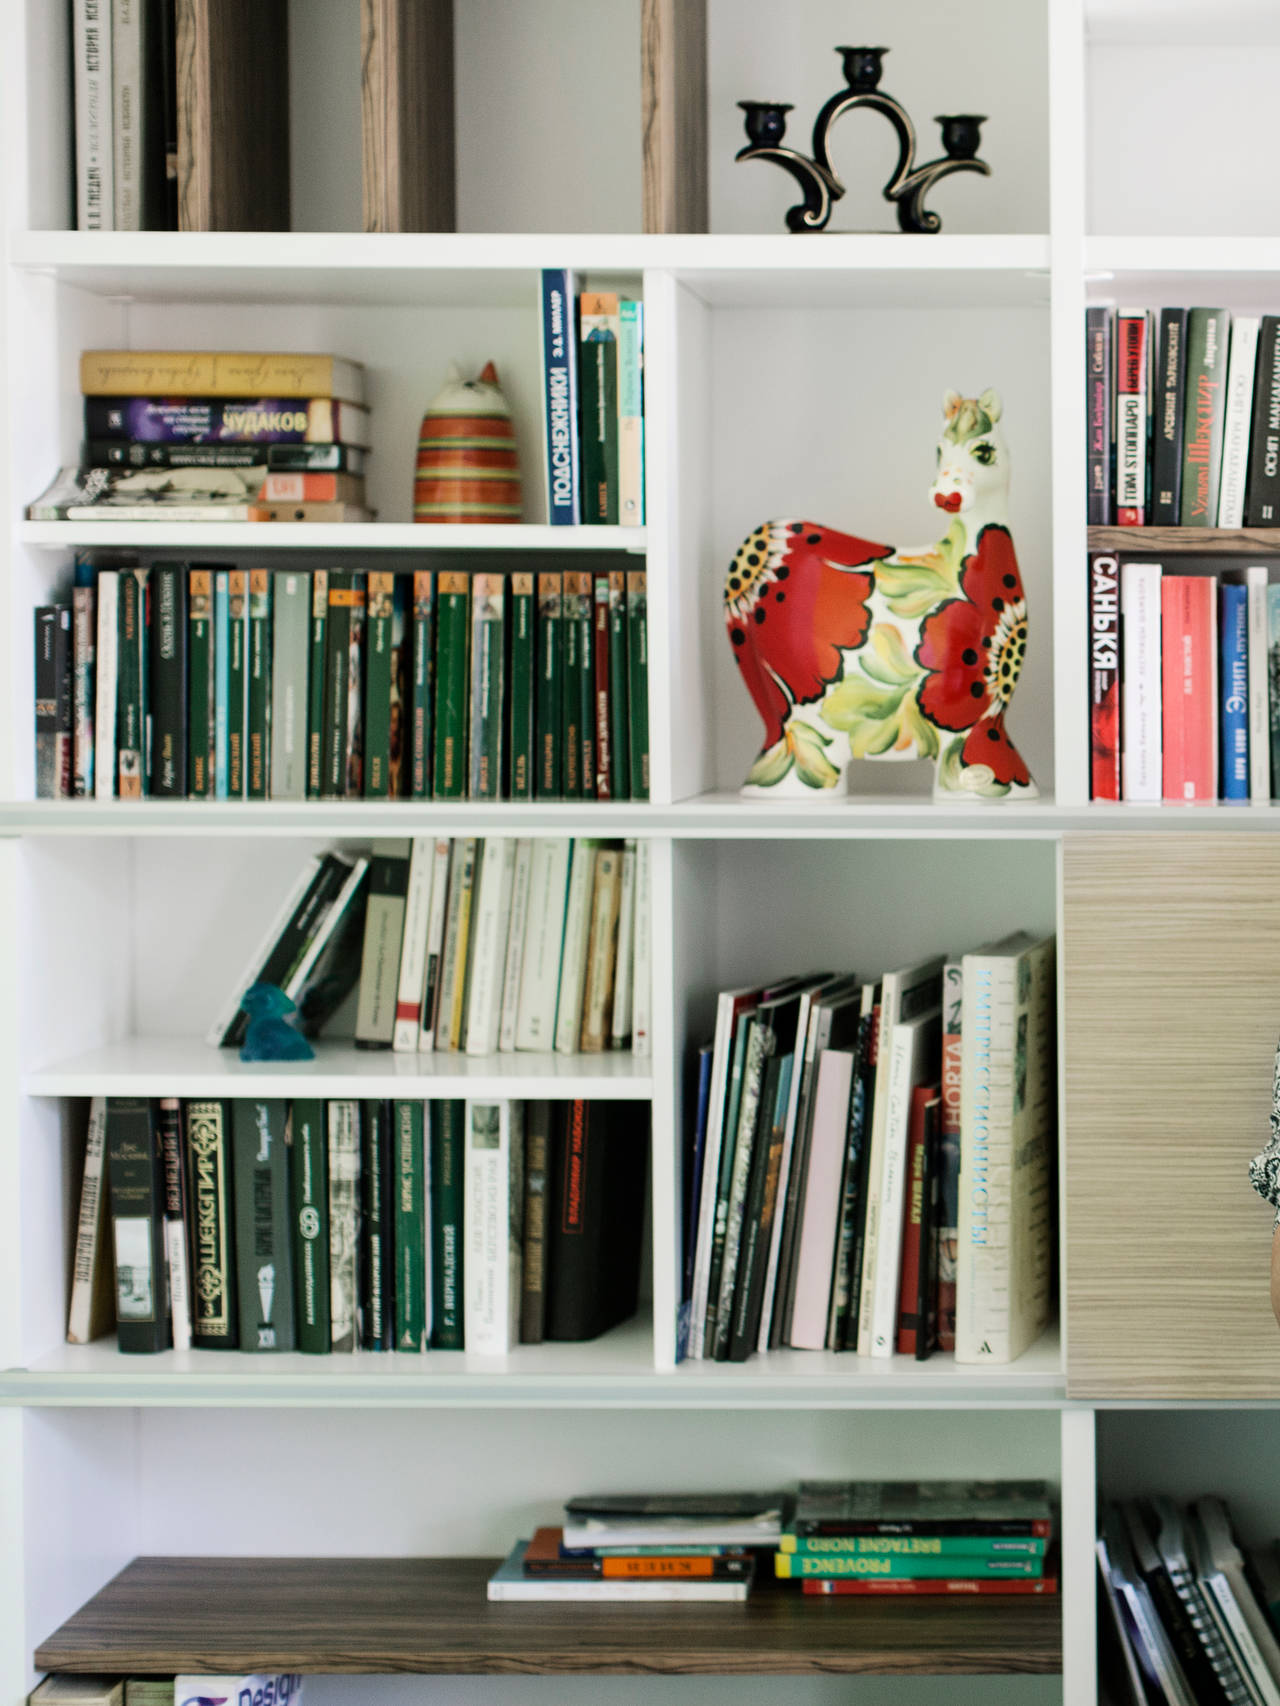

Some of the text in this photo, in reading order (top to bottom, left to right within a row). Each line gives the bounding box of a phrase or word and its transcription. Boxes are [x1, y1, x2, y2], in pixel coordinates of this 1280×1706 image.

[222, 411, 307, 434] ЧУДАКОВ
[1165, 322, 1179, 441] АРСЕНИЙ ТАРКОВСКИЙ
[551, 367, 572, 506] ПОДСНЕЖНИКИ
[1264, 435, 1279, 477] ОСИП
[1093, 557, 1118, 670] САНЬКЯ
[969, 968, 992, 1246] ИМПРЕССИОНИСТЫ
[197, 1156, 218, 1266] ШЕКСПИР
[567, 1156, 582, 1226] ВЛАДИМИР
[801, 1558, 892, 1574] PROVENCE
[806, 1538, 942, 1554] BRETAGNE NORD
